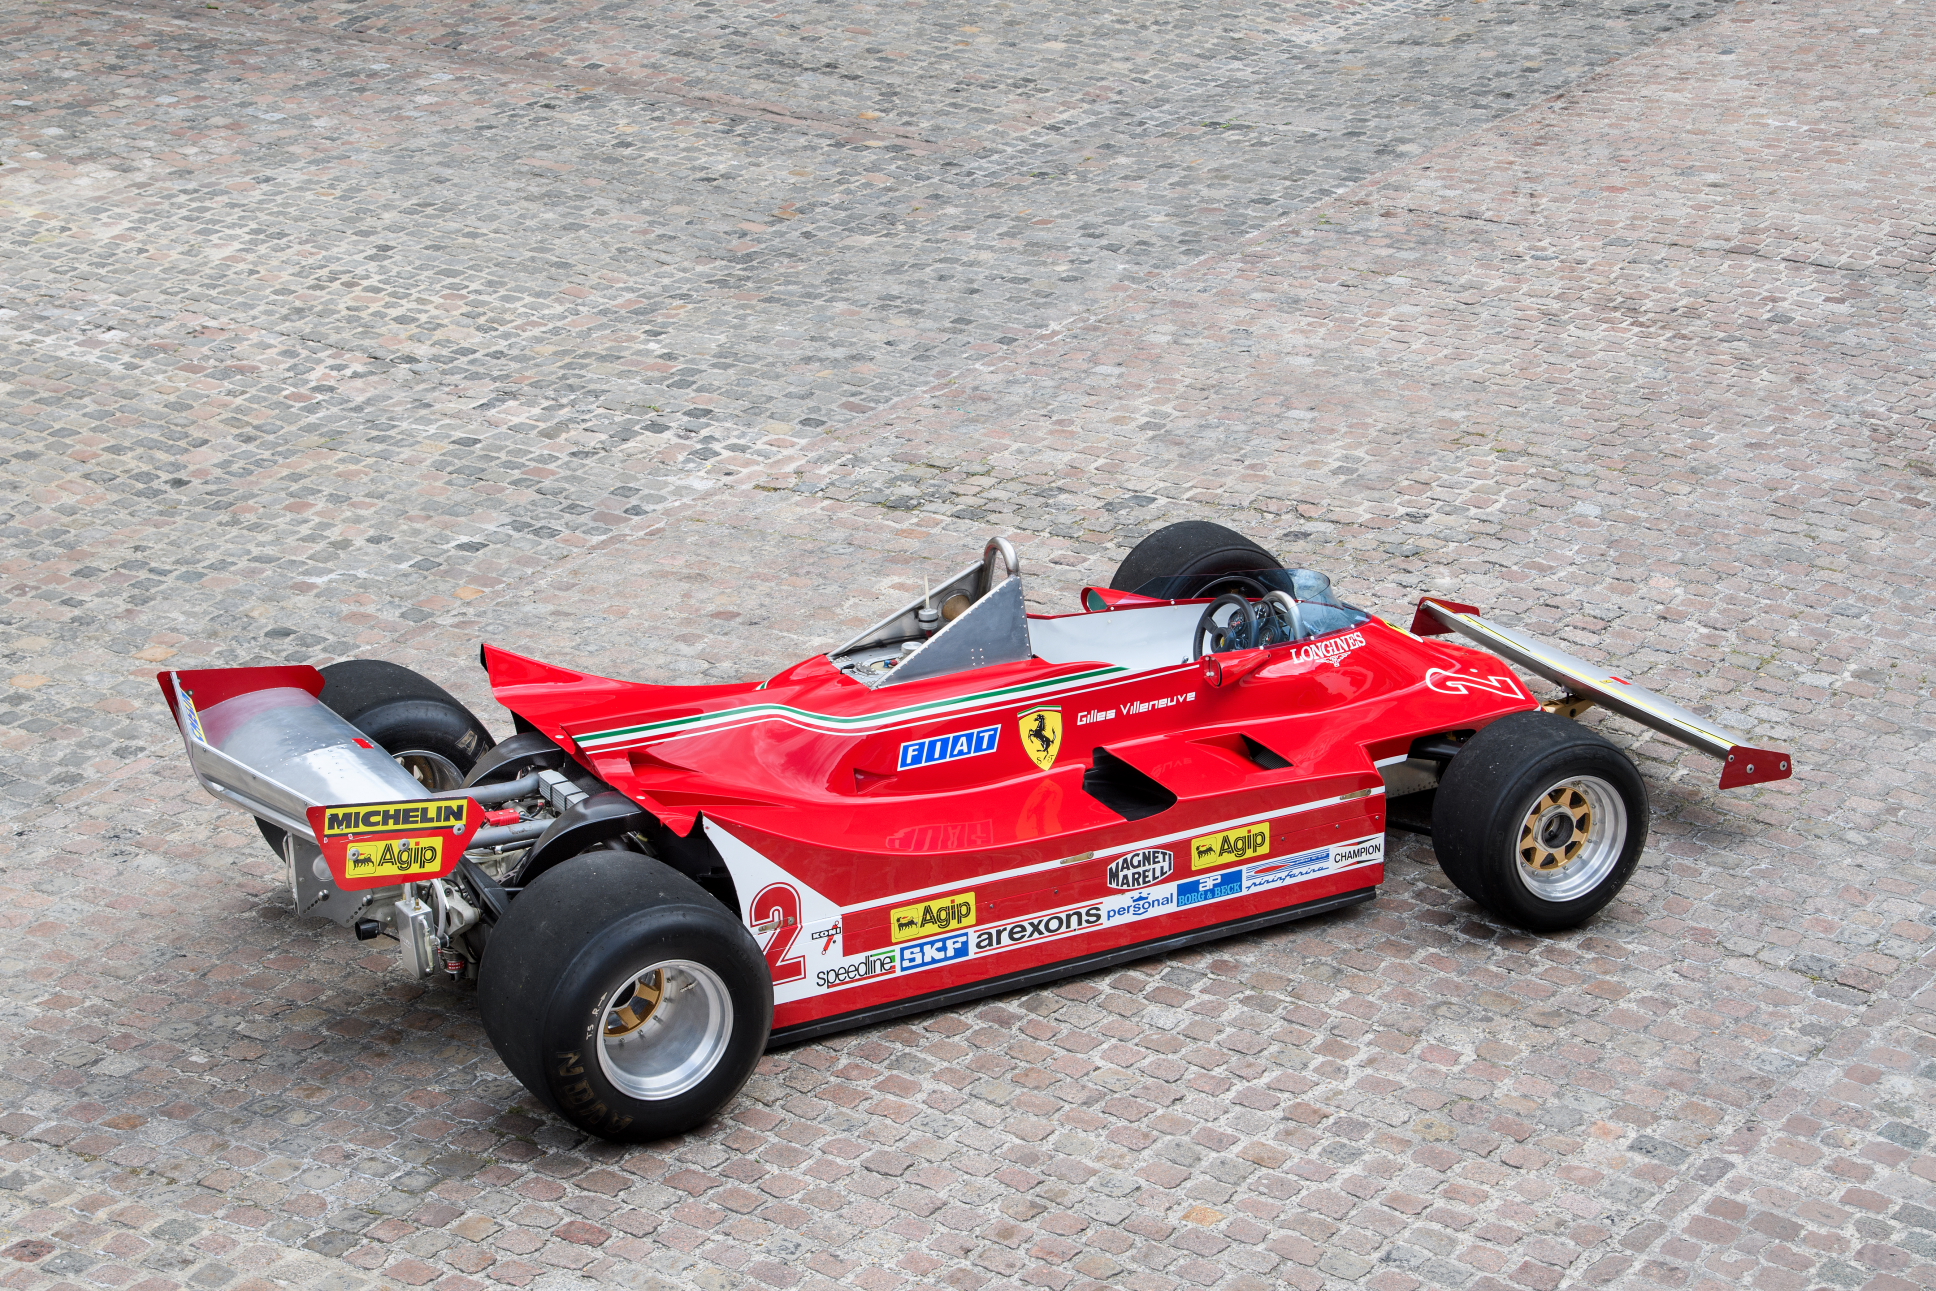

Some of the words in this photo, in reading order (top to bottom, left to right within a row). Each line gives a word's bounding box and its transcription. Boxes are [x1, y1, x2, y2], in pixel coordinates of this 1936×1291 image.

[1290, 632, 1366, 664] LONGINES
[1425, 668, 1525, 700] 2
[1077, 709, 1116, 725] Gilles
[1120, 691, 1196, 715] Villeneuve
[906, 730, 995, 762] FIAT
[327, 804, 464, 830] MICHELIN
[378, 841, 437, 871] Agip
[1218, 829, 1266, 857] Agip
[1334, 843, 1381, 864] CHAMPION
[1108, 850, 1172, 874] MAGNETI
[1108, 861, 1172, 887] MARELLI
[1245, 866, 1330, 892] pininfarina
[1107, 892, 1174, 921] personal
[1178, 891, 1205, 907] BORG
[1206, 891, 1213, 899] &
[1214, 882, 1241, 898] BECK
[919, 899, 971, 929] Agip
[975, 905, 1102, 950] arexons
[750, 881, 806, 986] 2
[812, 927, 841, 940] KONI
[902, 936, 968, 967] SKF
[816, 953, 893, 989] speedline
